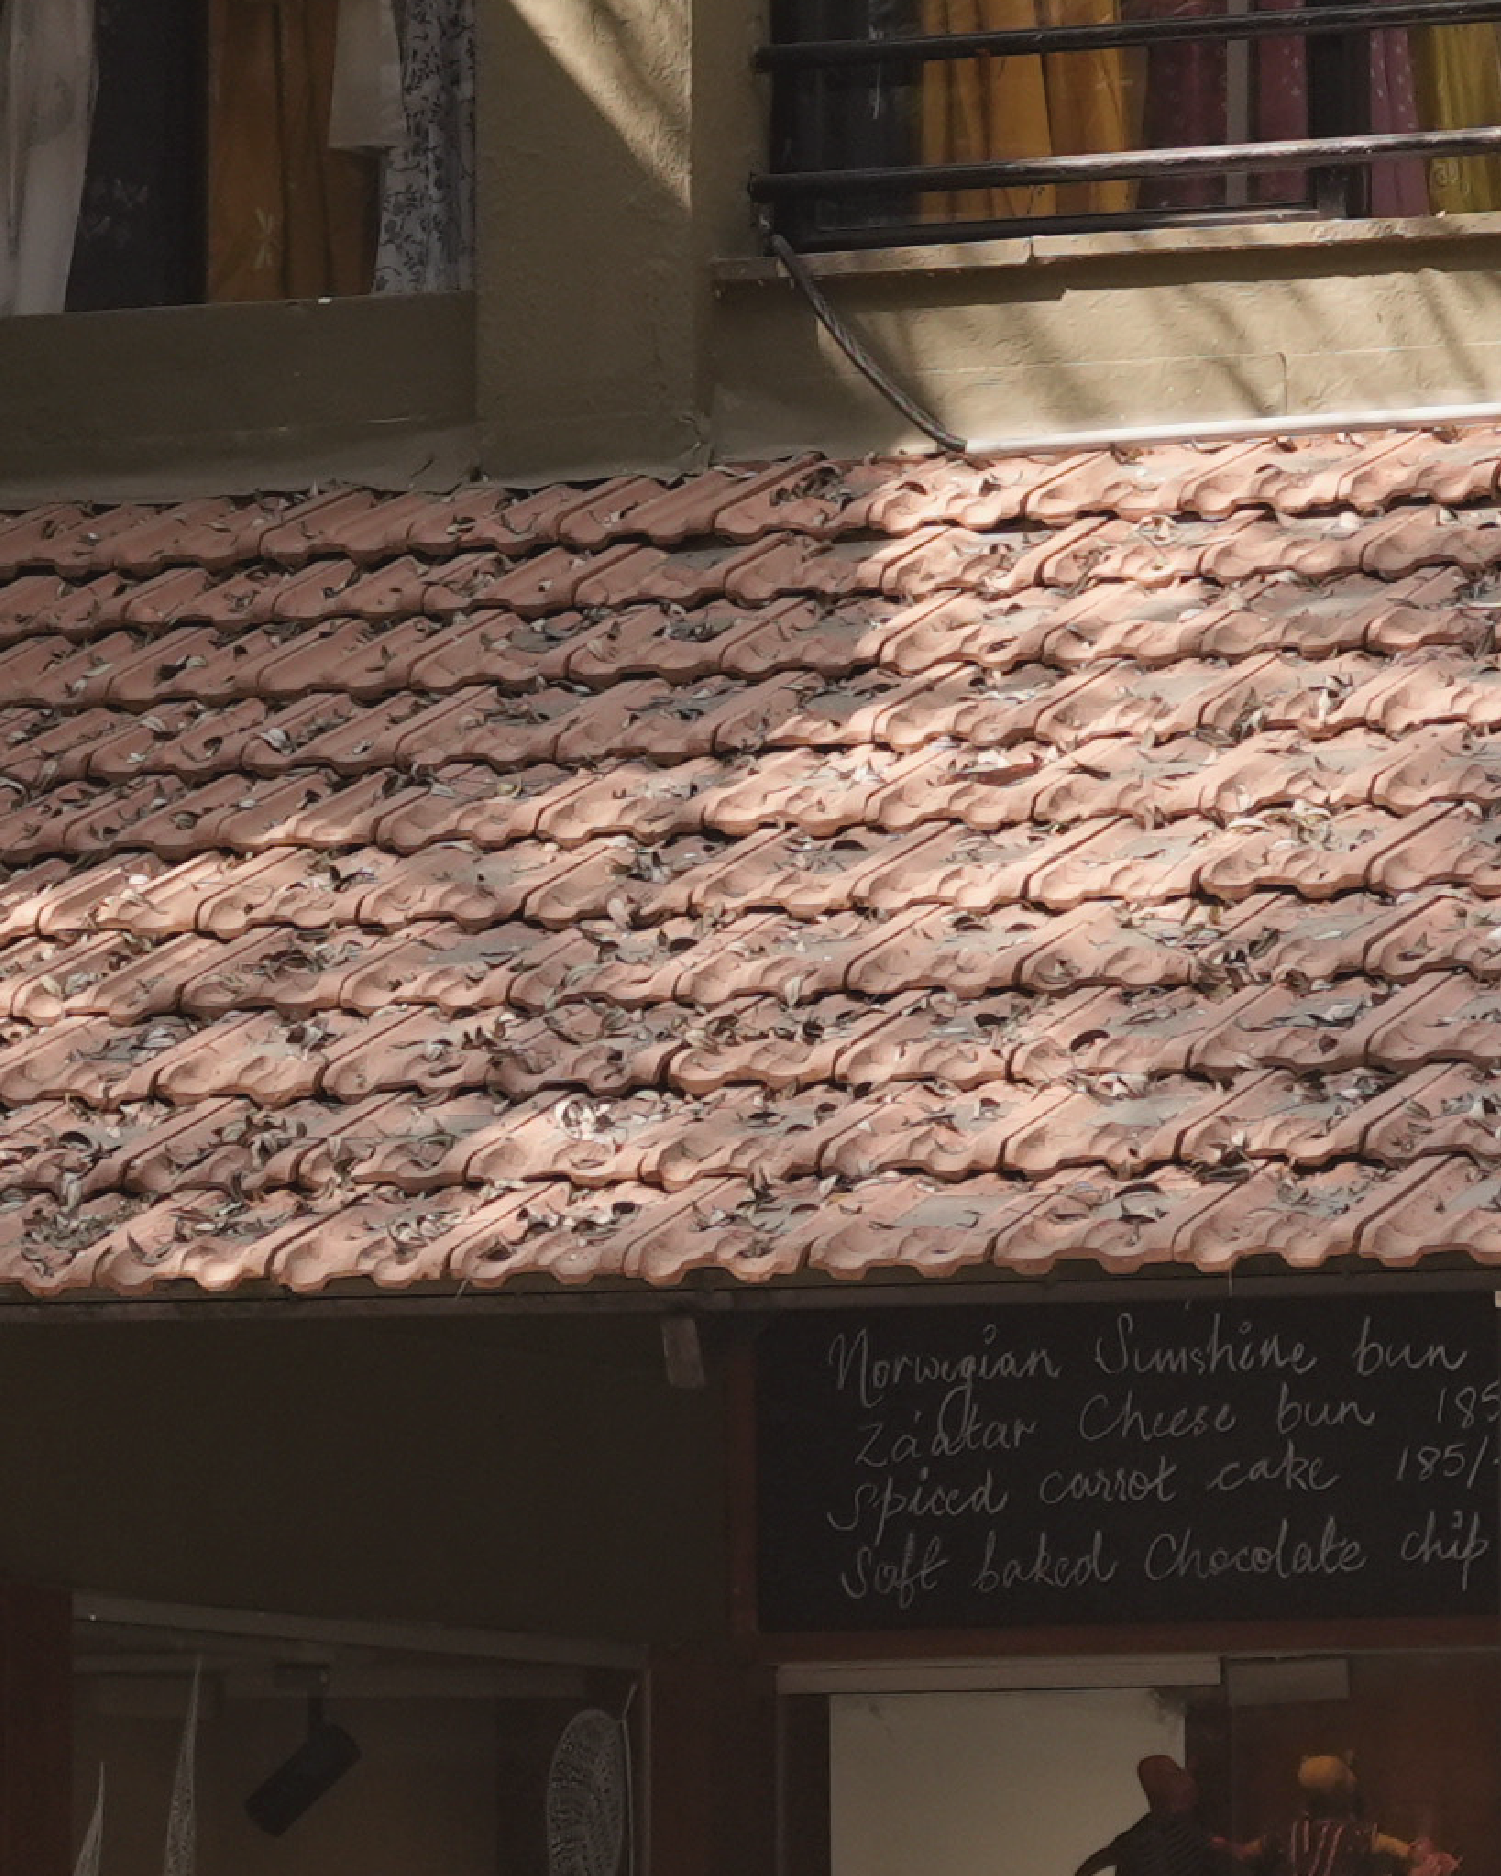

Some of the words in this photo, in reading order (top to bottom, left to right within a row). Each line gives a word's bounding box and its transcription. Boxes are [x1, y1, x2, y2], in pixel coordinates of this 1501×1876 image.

[1353, 1316, 1468, 1376] bun
[1079, 1390, 1237, 1442] Cheese
[1277, 1382, 1376, 1437] bun
[1040, 1456, 1179, 1505] carrot
[1206, 1439, 1341, 1492] cake
[841, 1530, 949, 1610] Soft
[972, 1529, 1119, 1593] baked
[1144, 1516, 1367, 1582] Chocolate
[1400, 1508, 1491, 1592] chip
